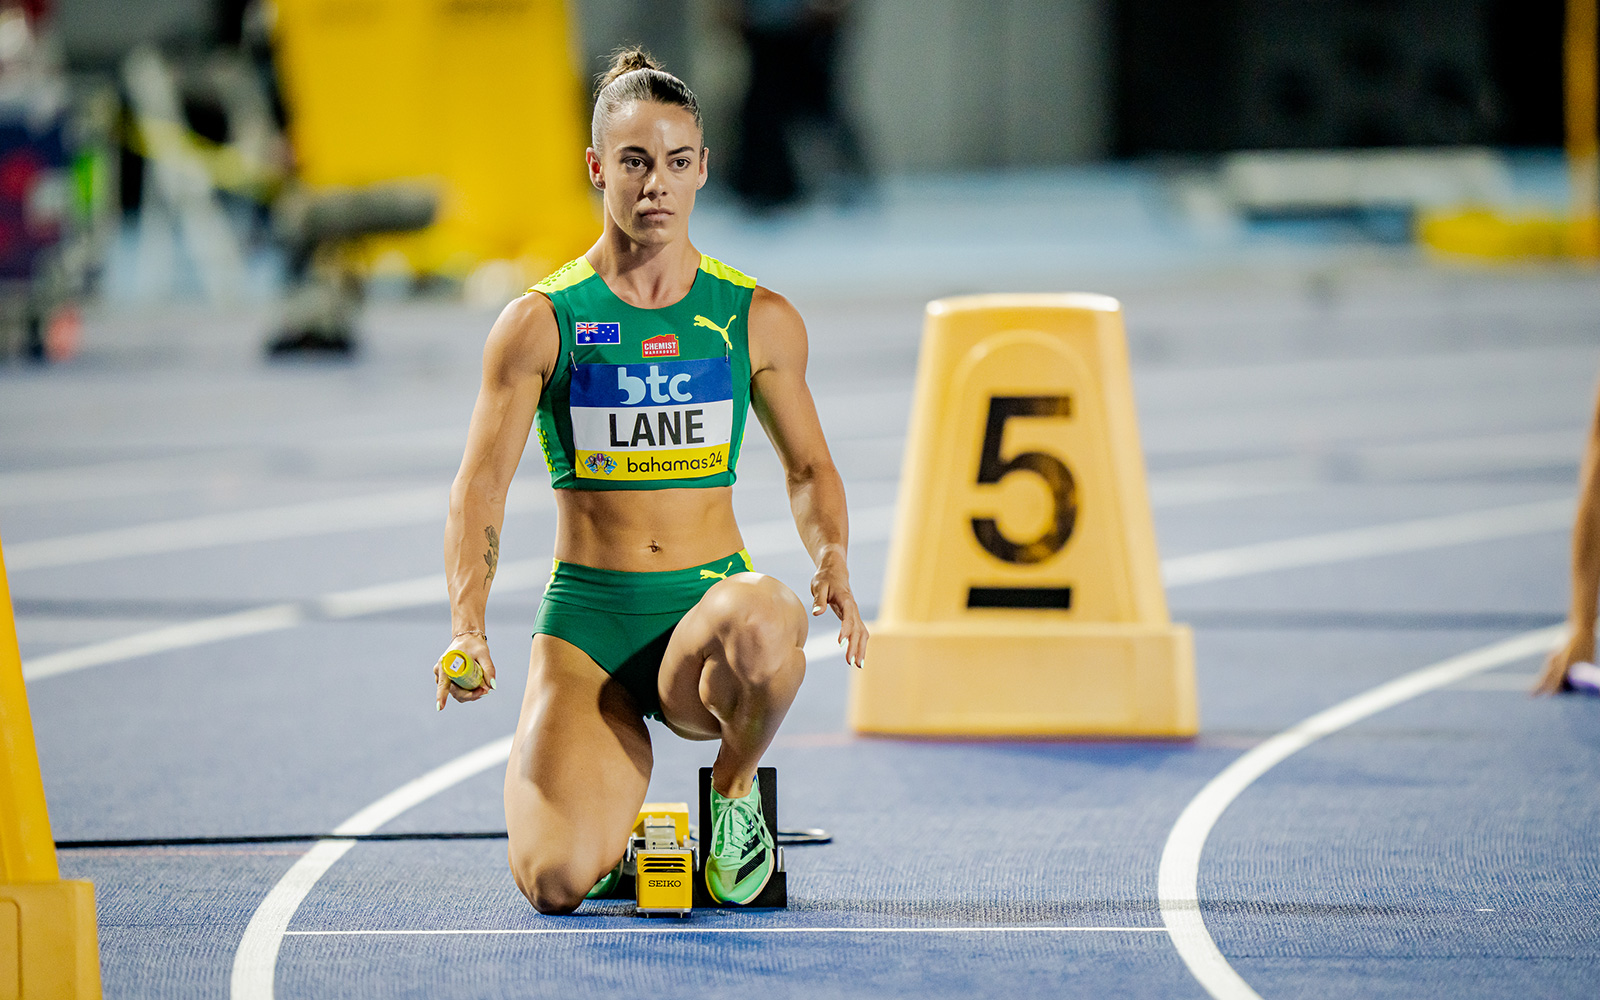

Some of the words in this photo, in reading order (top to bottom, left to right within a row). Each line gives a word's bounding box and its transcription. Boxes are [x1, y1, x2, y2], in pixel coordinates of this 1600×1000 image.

[644, 342, 676, 350] CHEMIST
[617, 366, 693, 405] btc
[609, 409, 705, 447] LANE
[627, 451, 723, 473] bahamas24
[971, 396, 1077, 565] 5
[648, 879, 682, 888] SEIKO
